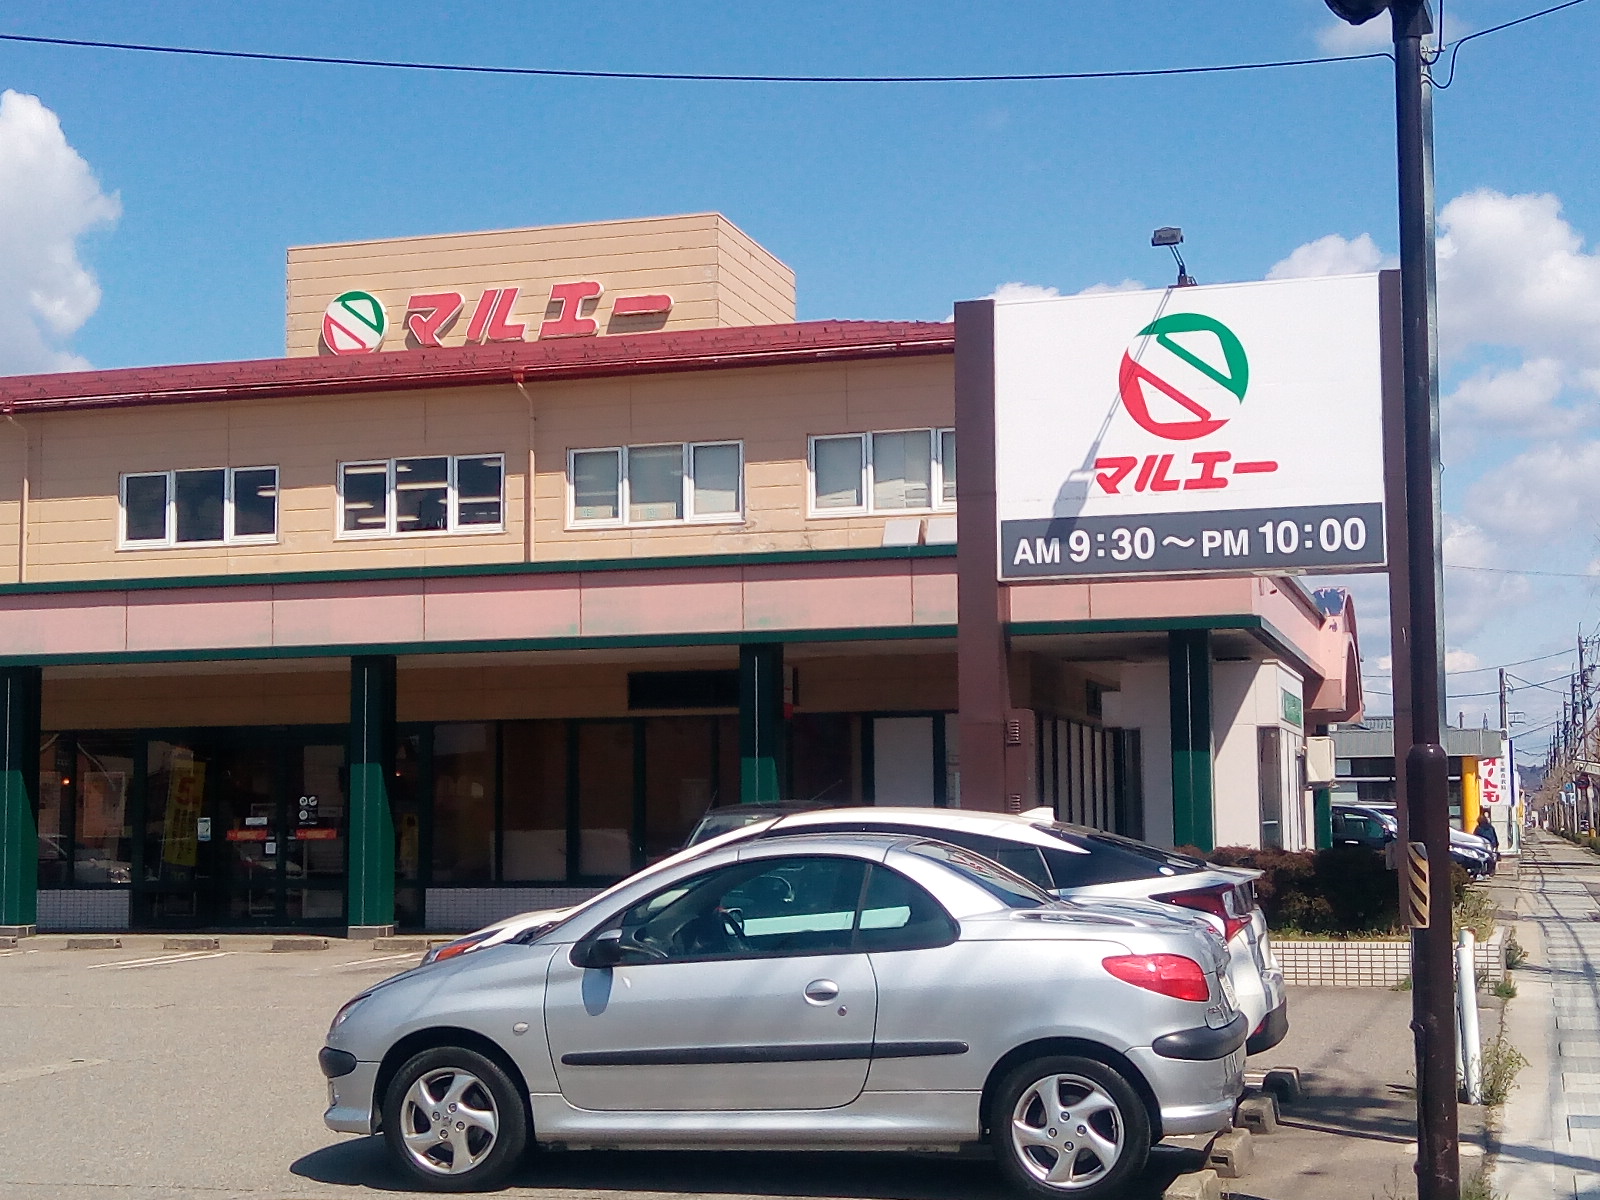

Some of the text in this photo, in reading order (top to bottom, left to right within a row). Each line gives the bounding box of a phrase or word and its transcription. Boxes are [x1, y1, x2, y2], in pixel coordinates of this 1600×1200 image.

[406, 281, 674, 347] マルエー
[1094, 450, 1279, 495] マルエー
[1013, 537, 1060, 565] AM
[1068, 526, 1156, 563] 9:30
[1202, 528, 1249, 557] PM
[1258, 517, 1367, 554] 10:00
